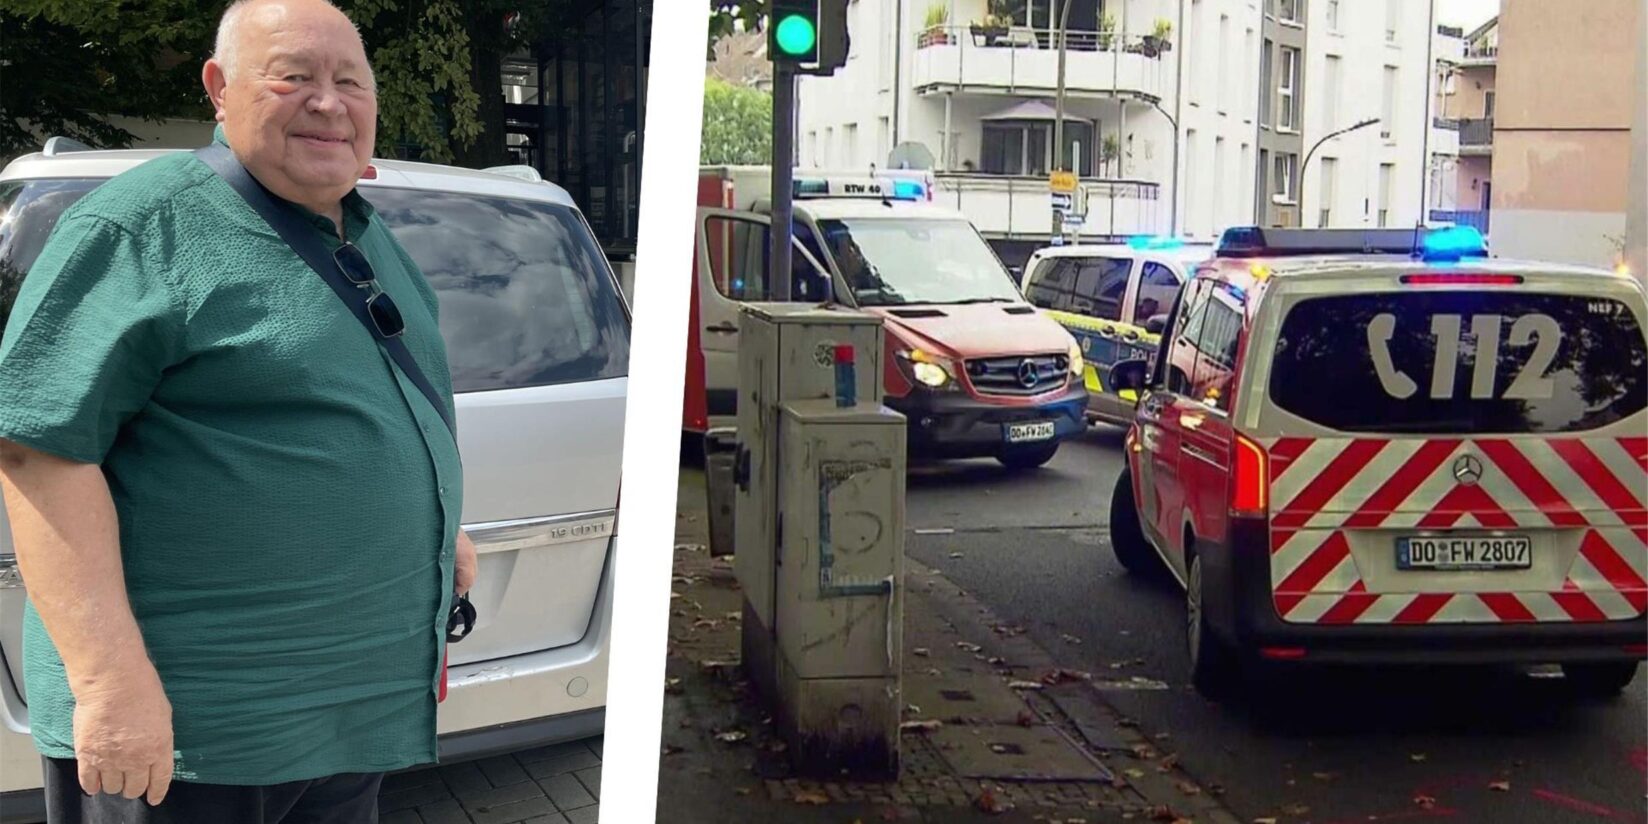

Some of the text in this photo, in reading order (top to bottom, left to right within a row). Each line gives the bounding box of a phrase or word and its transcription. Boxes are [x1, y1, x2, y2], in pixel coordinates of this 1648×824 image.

[844, 184, 865, 193] RTW
[1588, 303, 1612, 314] NEF
[1430, 314, 1561, 398] 112
[1411, 541, 1527, 562] DO FW 2807
